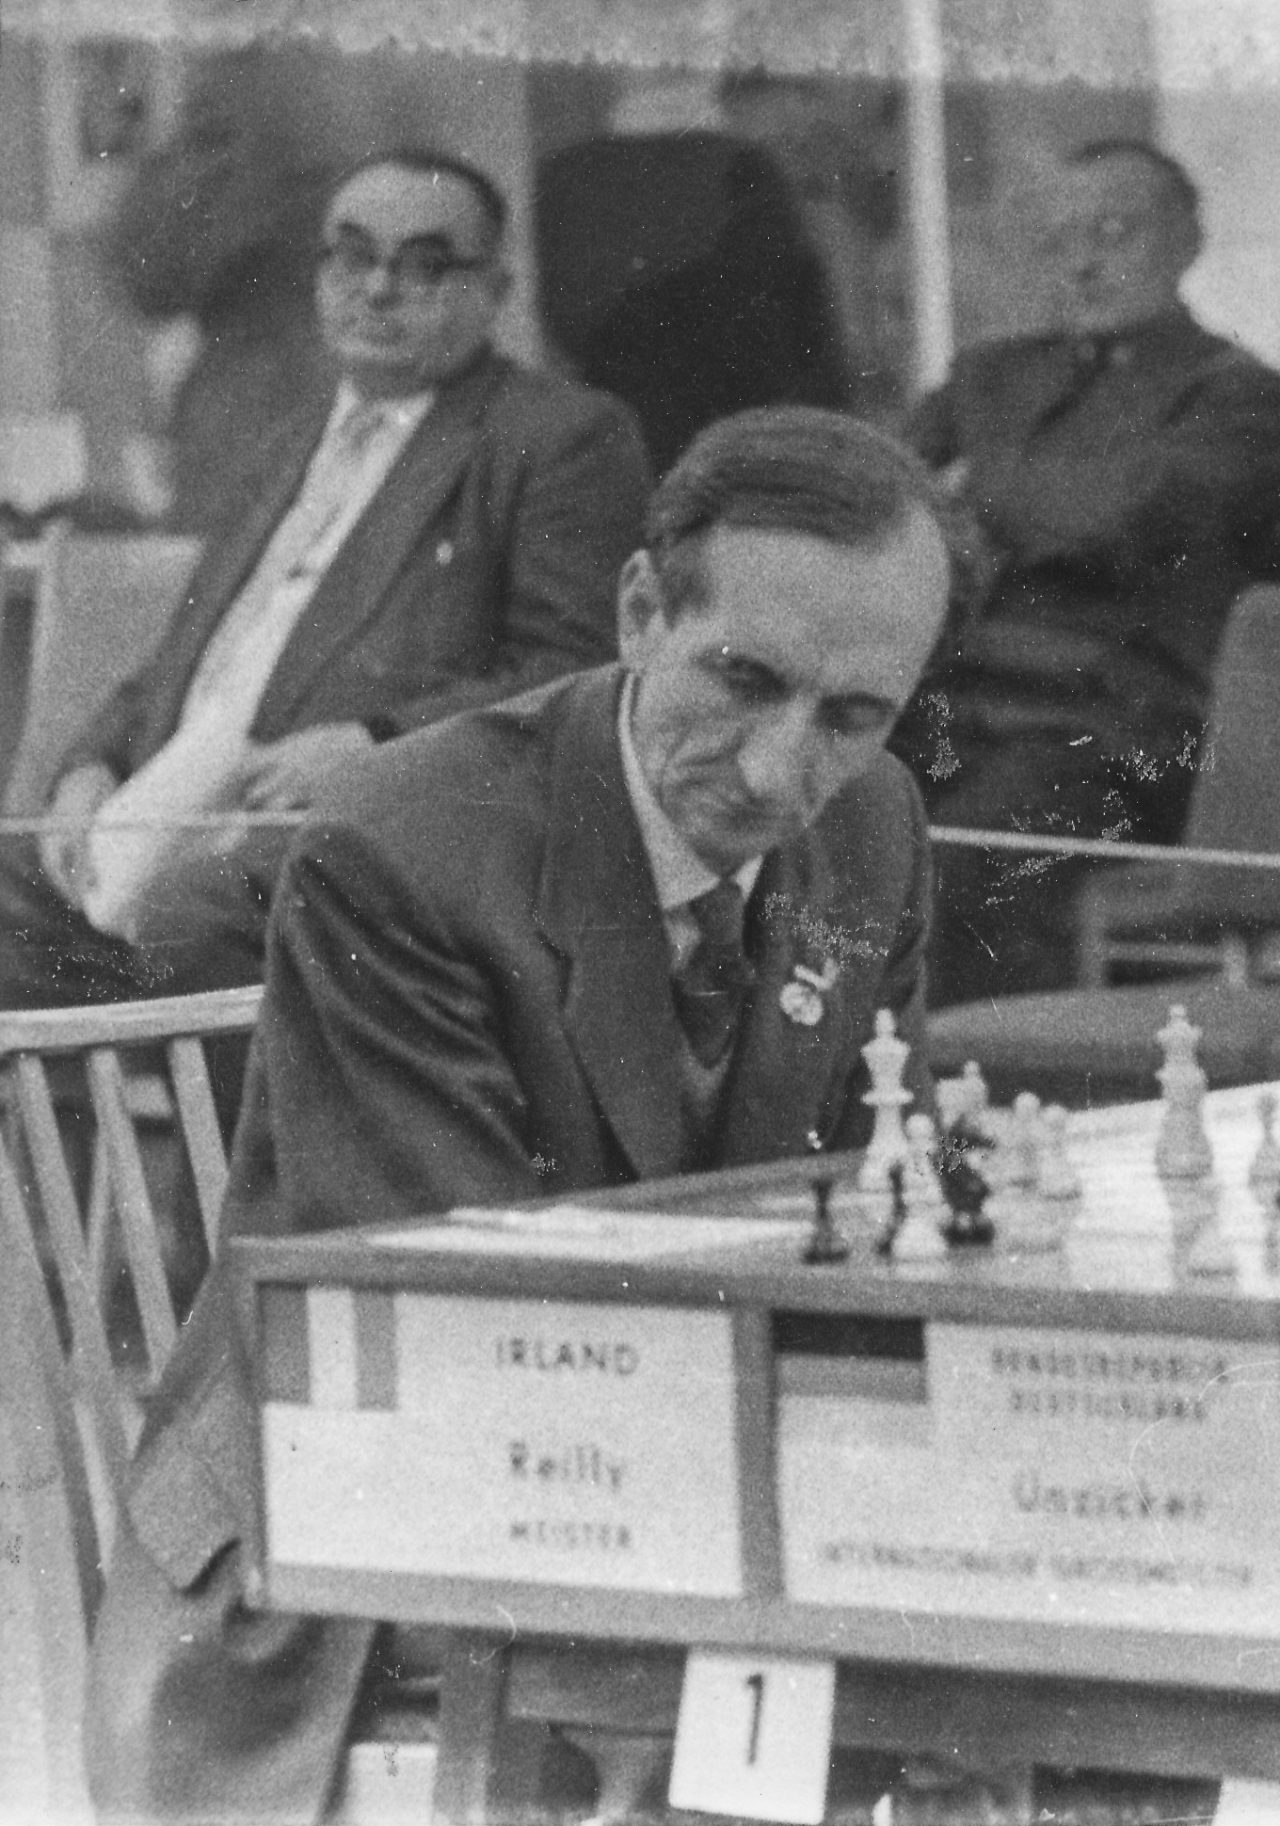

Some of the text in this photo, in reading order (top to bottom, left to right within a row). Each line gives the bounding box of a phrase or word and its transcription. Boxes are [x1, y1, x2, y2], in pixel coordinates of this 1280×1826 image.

[495, 1336, 640, 1376] IRLAND
[508, 1439, 626, 1494] Reilly
[1012, 1467, 1207, 1520] Unzicker
[508, 1519, 632, 1550] MEISTER
[745, 1673, 764, 1767] 1
